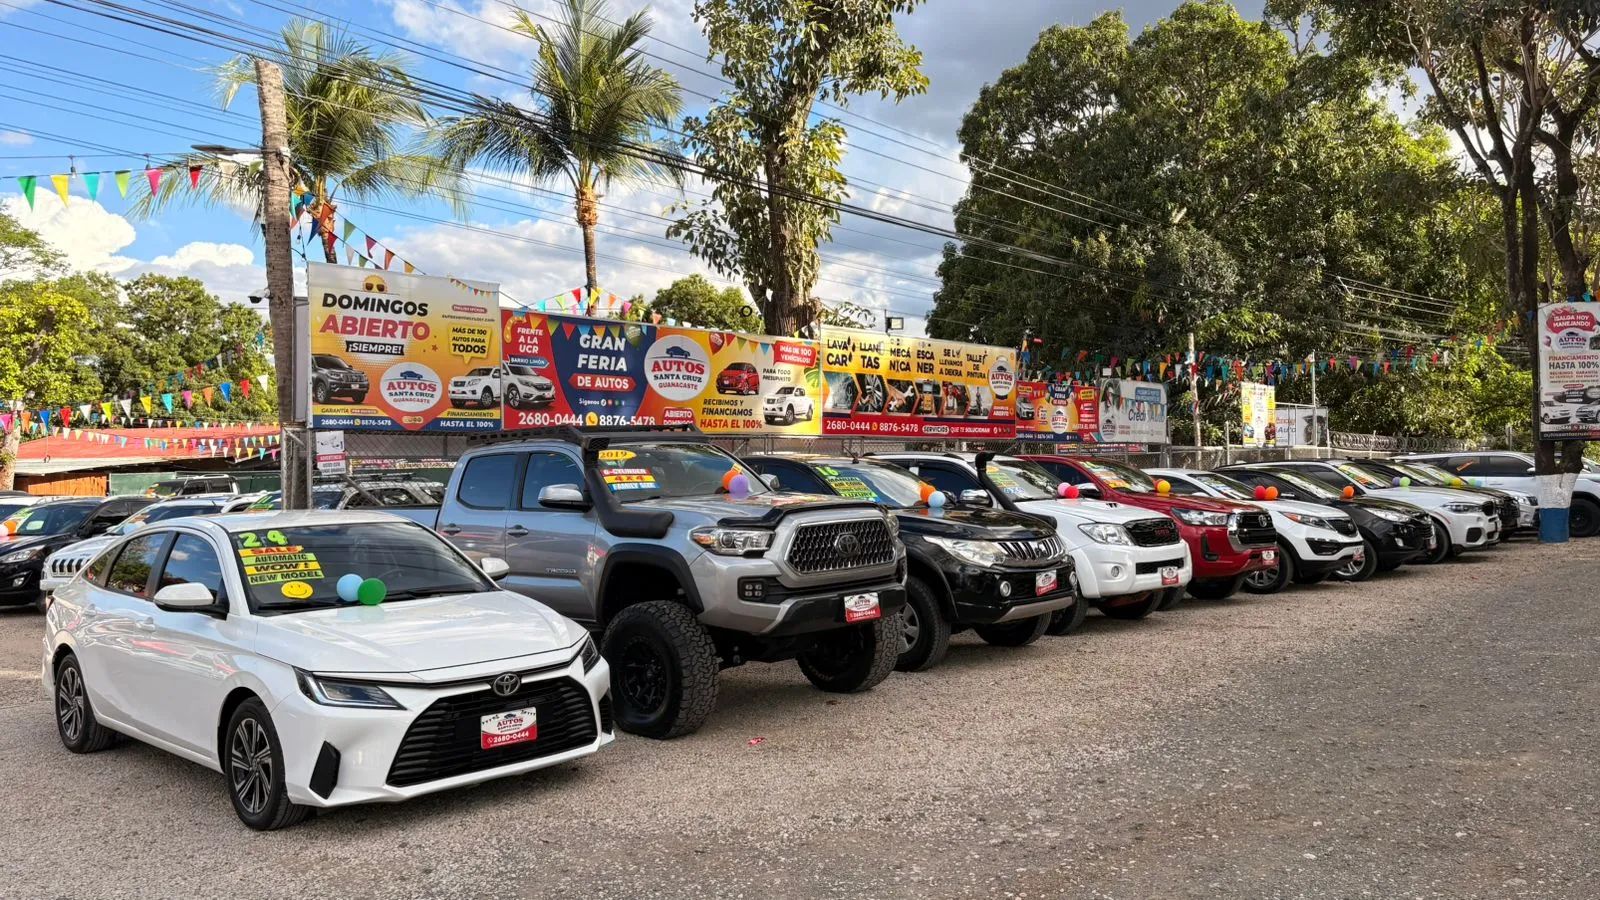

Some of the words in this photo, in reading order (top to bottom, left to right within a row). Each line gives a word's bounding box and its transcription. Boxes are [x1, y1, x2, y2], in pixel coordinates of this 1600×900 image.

[322, 293, 428, 316] DOMINGOS
[319, 314, 430, 340] ABIERTO
[517, 327, 544, 336] FRENTE
[527, 336, 538, 344] LA
[580, 335, 626, 351] GRAN
[828, 339, 848, 350] LAVA
[349, 341, 402, 354] ¡SIEMPRE!
[452, 343, 486, 354] TODOS
[519, 345, 539, 354] UCR
[890, 347, 911, 358] MECÁ
[827, 353, 847, 366] CAR
[917, 350, 934, 360] ESCA
[577, 354, 627, 371] FERIA
[651, 361, 704, 375] AUTOS
[861, 356, 880, 369] TAS
[890, 360, 911, 372] NICA
[917, 362, 934, 374] NER
[386, 382, 437, 392] AUTOS
[578, 376, 591, 387] DE
[595, 378, 628, 389] AUTOS
[658, 382, 698, 390] GUANACASTE
[702, 408, 752, 416] FINANCIAMOS
[518, 412, 583, 426] 2680-0444
[599, 415, 656, 426] 8876-5478
[700, 419, 728, 428] HASTA
[731, 420, 740, 428] EL
[743, 420, 762, 428] 100%
[826, 420, 870, 430] 2680-0444
[879, 423, 918, 432] 8876-5478
[250, 546, 297, 554] SALE
[255, 554, 308, 562] AUTOMATIC
[497, 718, 523, 727] AUTOS
[494, 731, 529, 743] 2680-0444
